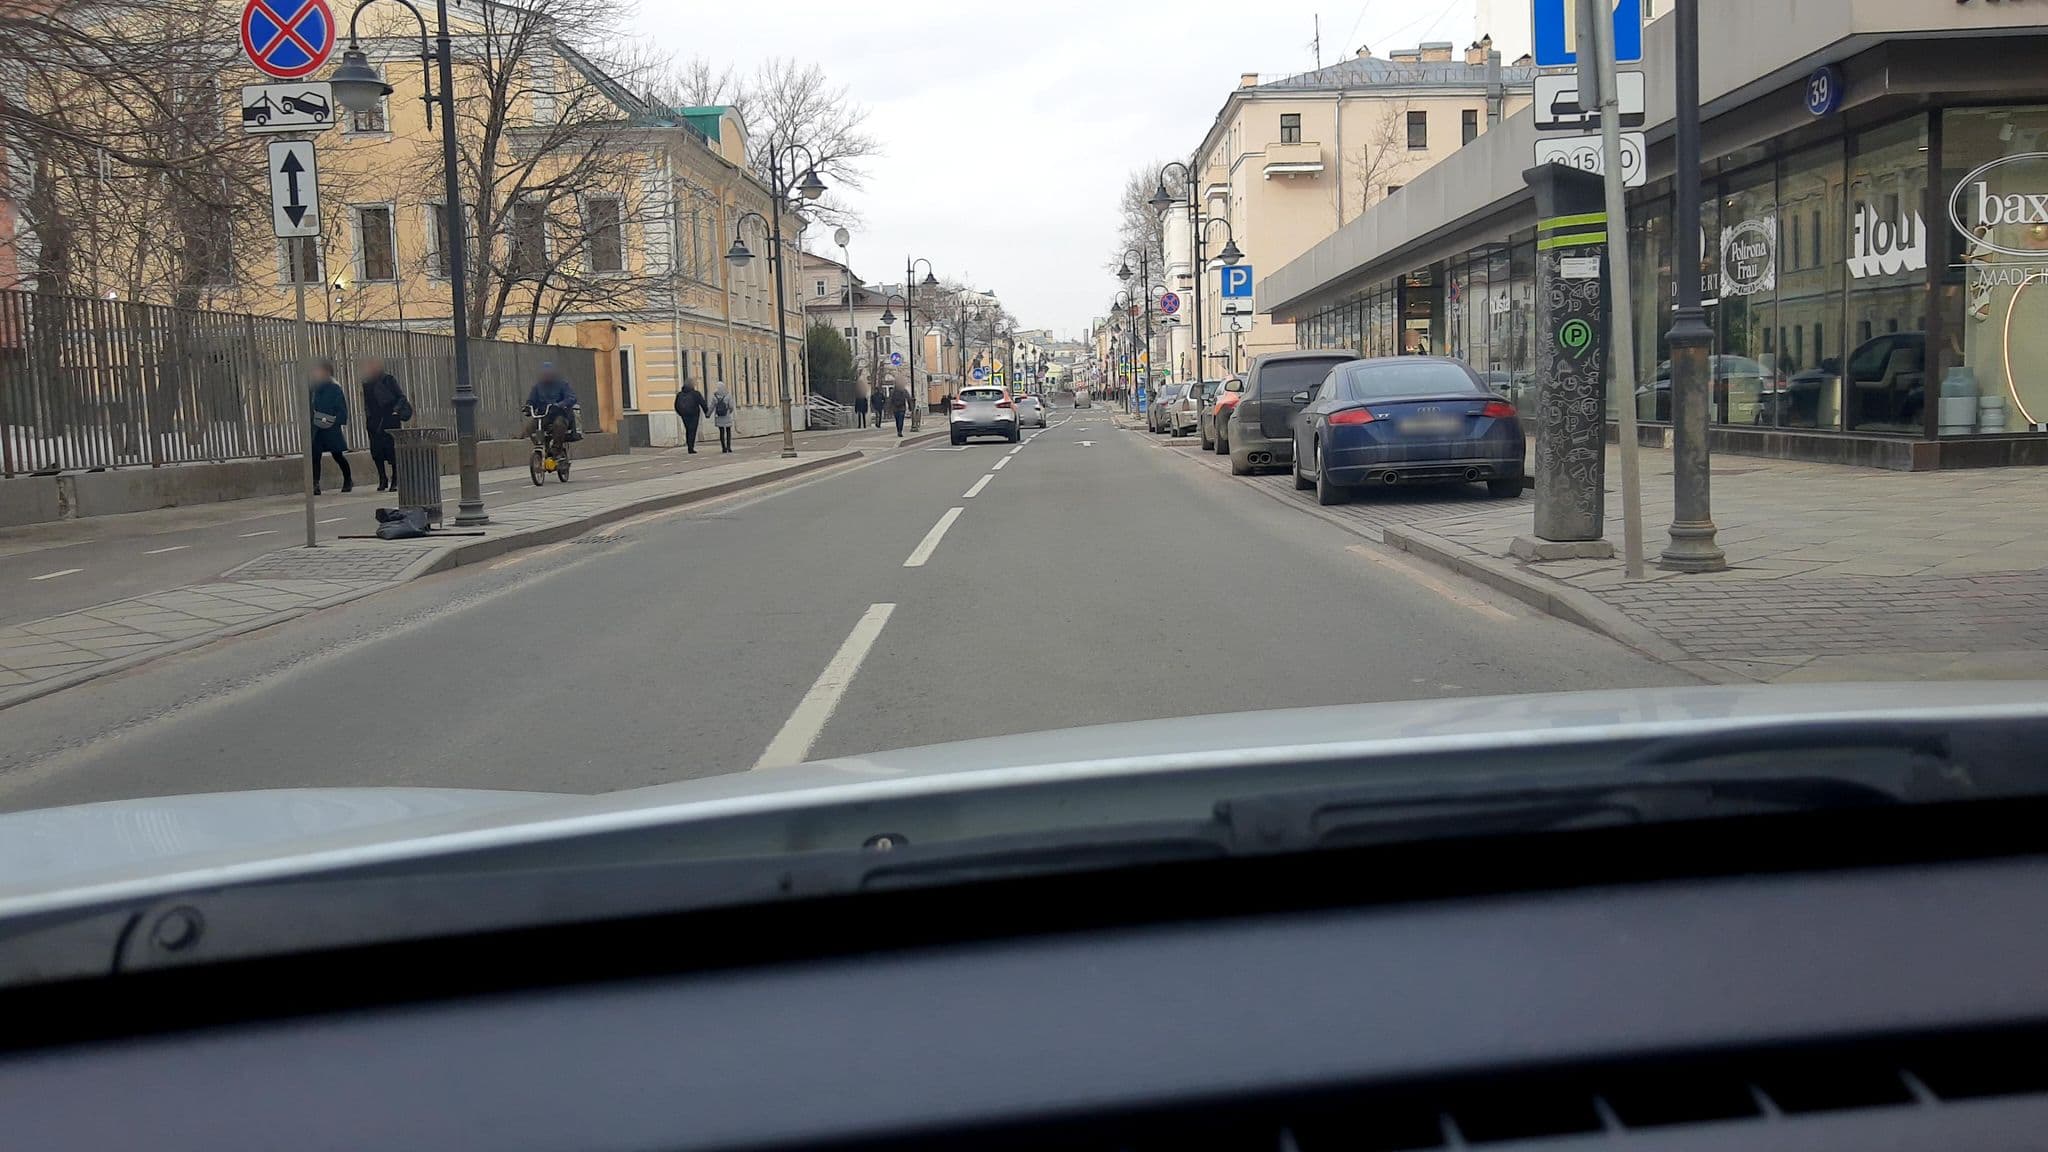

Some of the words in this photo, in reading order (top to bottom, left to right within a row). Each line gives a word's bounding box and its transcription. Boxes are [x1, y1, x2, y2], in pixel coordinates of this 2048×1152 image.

[1811, 75, 1828, 106] 39
[1574, 153, 1595, 170] 15
[1731, 240, 1768, 262] Poltrona
[1846, 203, 1927, 279] flou
[1737, 261, 1757, 280] Frau
[1980, 267, 2033, 287] MADE
[1229, 268, 1247, 295] P
[1570, 328, 1582, 343] P
